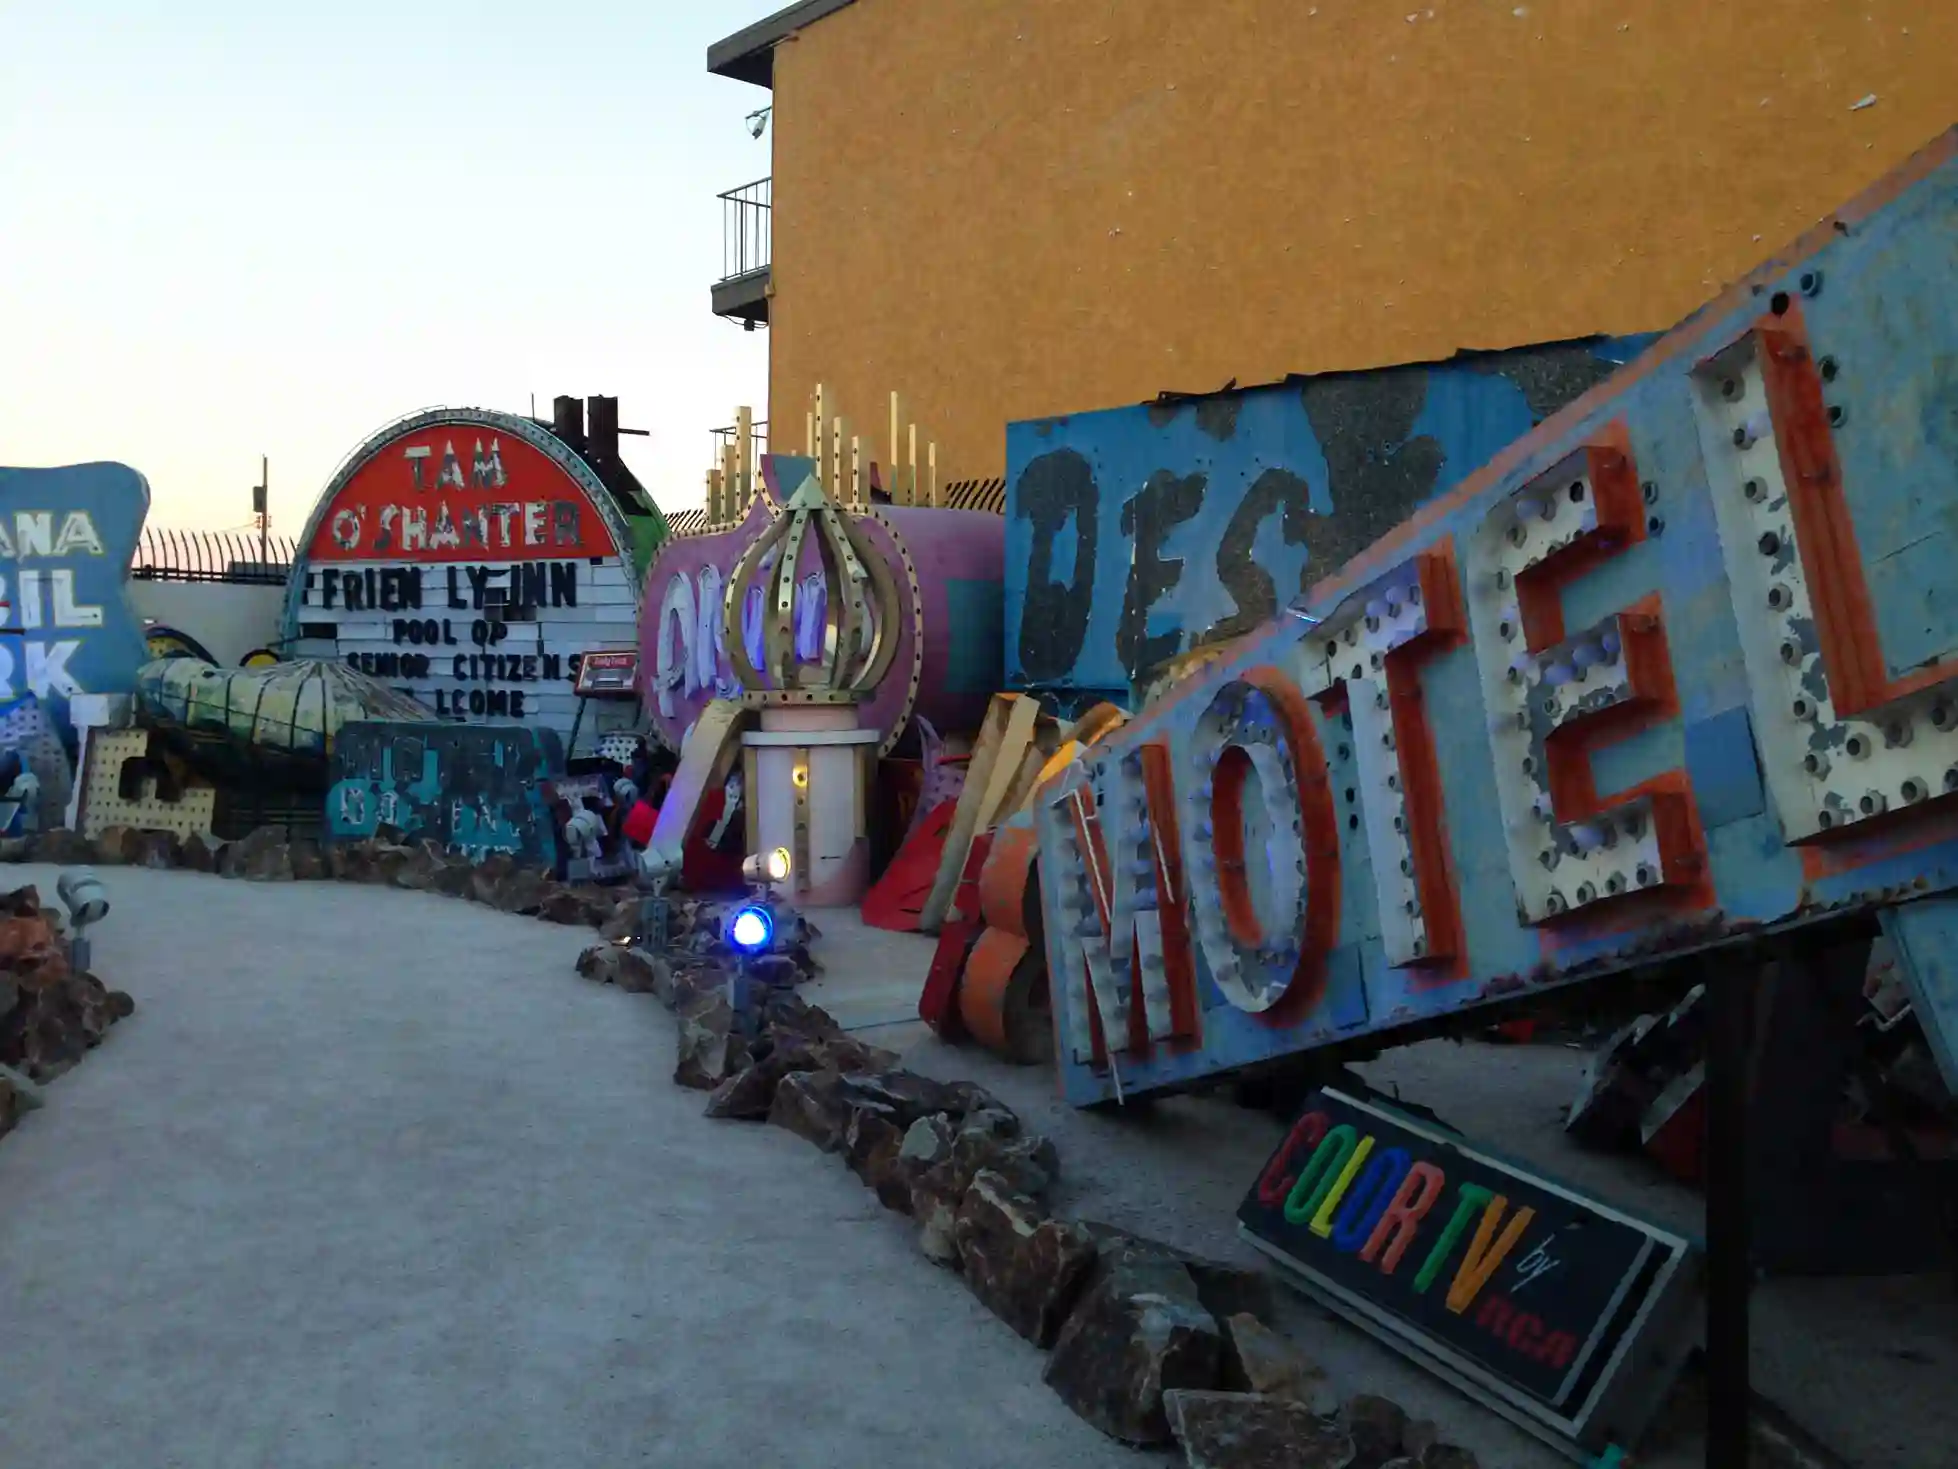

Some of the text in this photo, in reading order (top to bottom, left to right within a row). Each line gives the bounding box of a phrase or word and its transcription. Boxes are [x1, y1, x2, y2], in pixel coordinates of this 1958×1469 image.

[403, 437, 508, 491] TAM
[332, 498, 583, 551] O'SHANTER
[392, 617, 458, 647] POOL
[1048, 325, 1958, 1068] MOTEL
[1258, 1110, 1537, 1316] COLOR TV
[1509, 1232, 1562, 1294] by
